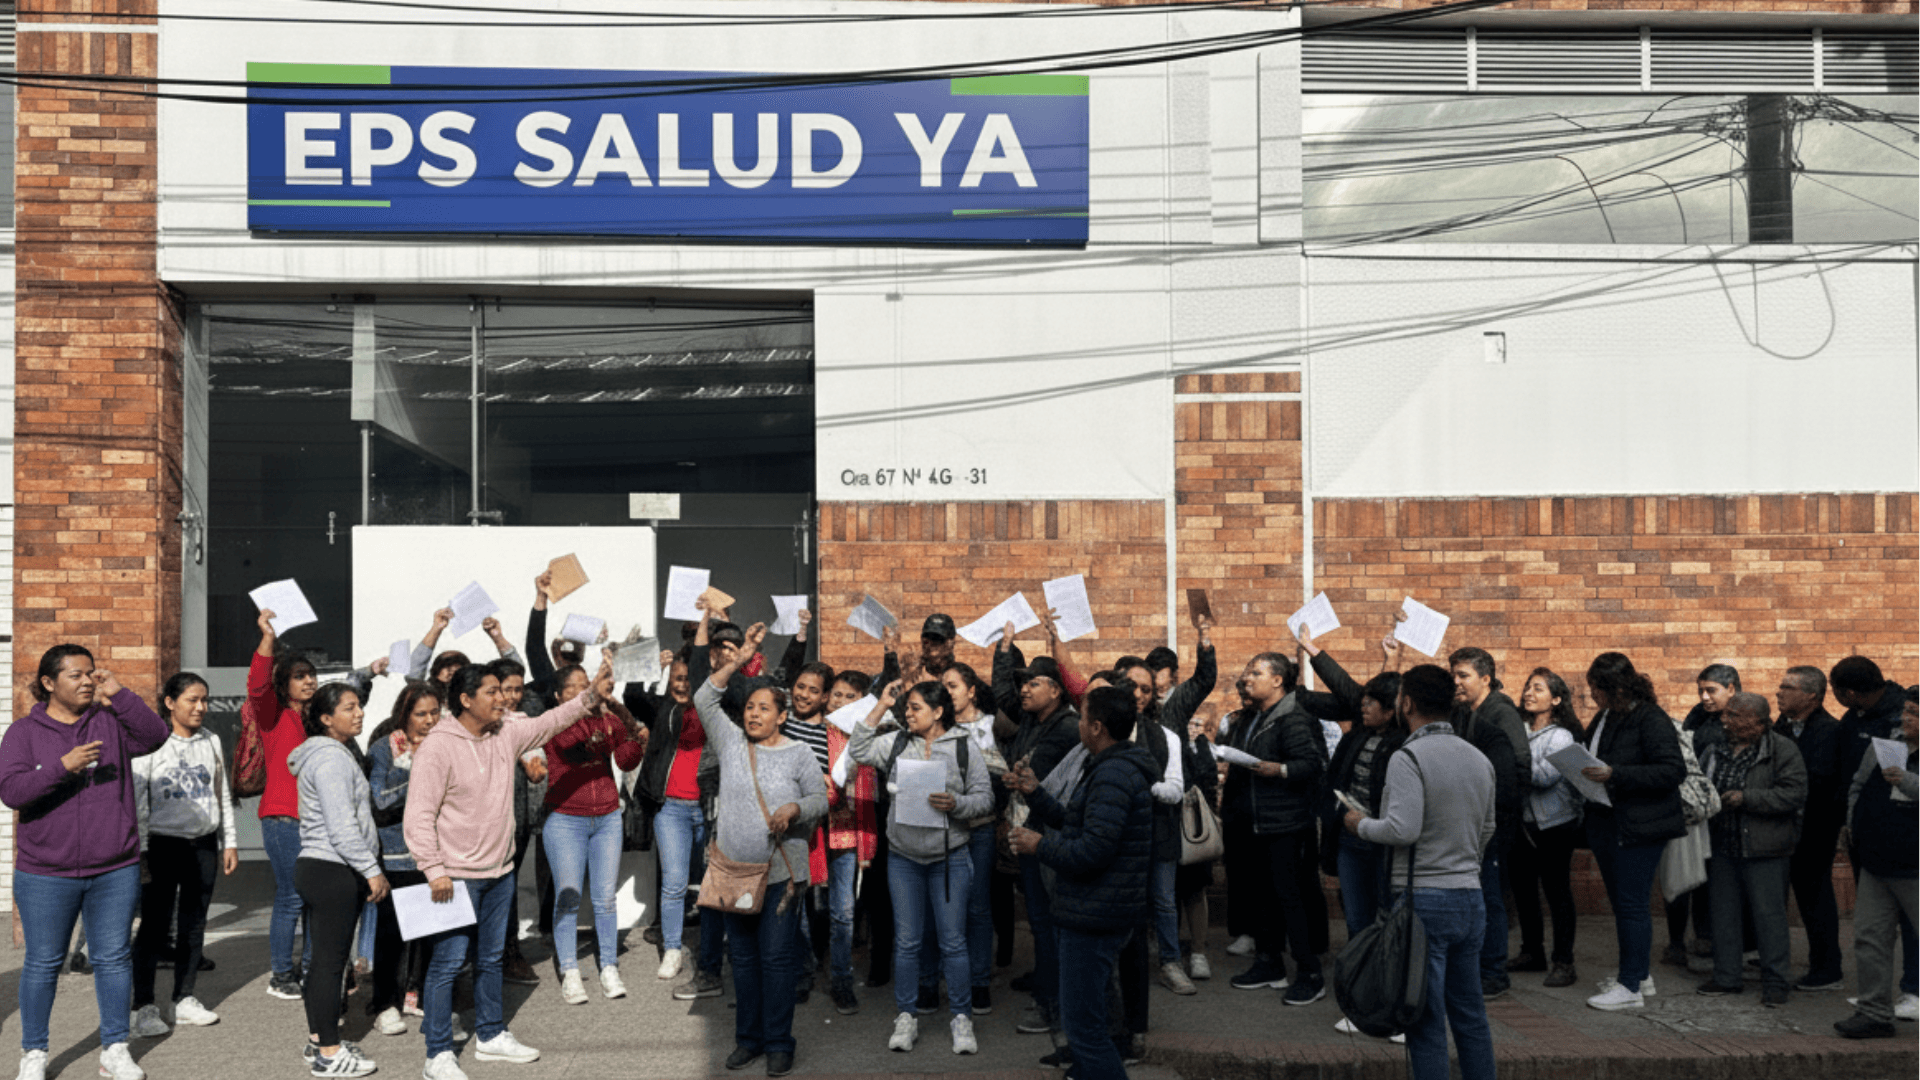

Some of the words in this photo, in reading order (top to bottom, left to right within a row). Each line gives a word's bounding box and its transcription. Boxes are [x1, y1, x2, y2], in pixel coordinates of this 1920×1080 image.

[284, 110, 477, 187] EPS
[513, 110, 863, 189] SALUD
[893, 112, 1039, 188] YA
[875, 467, 897, 486] 67
